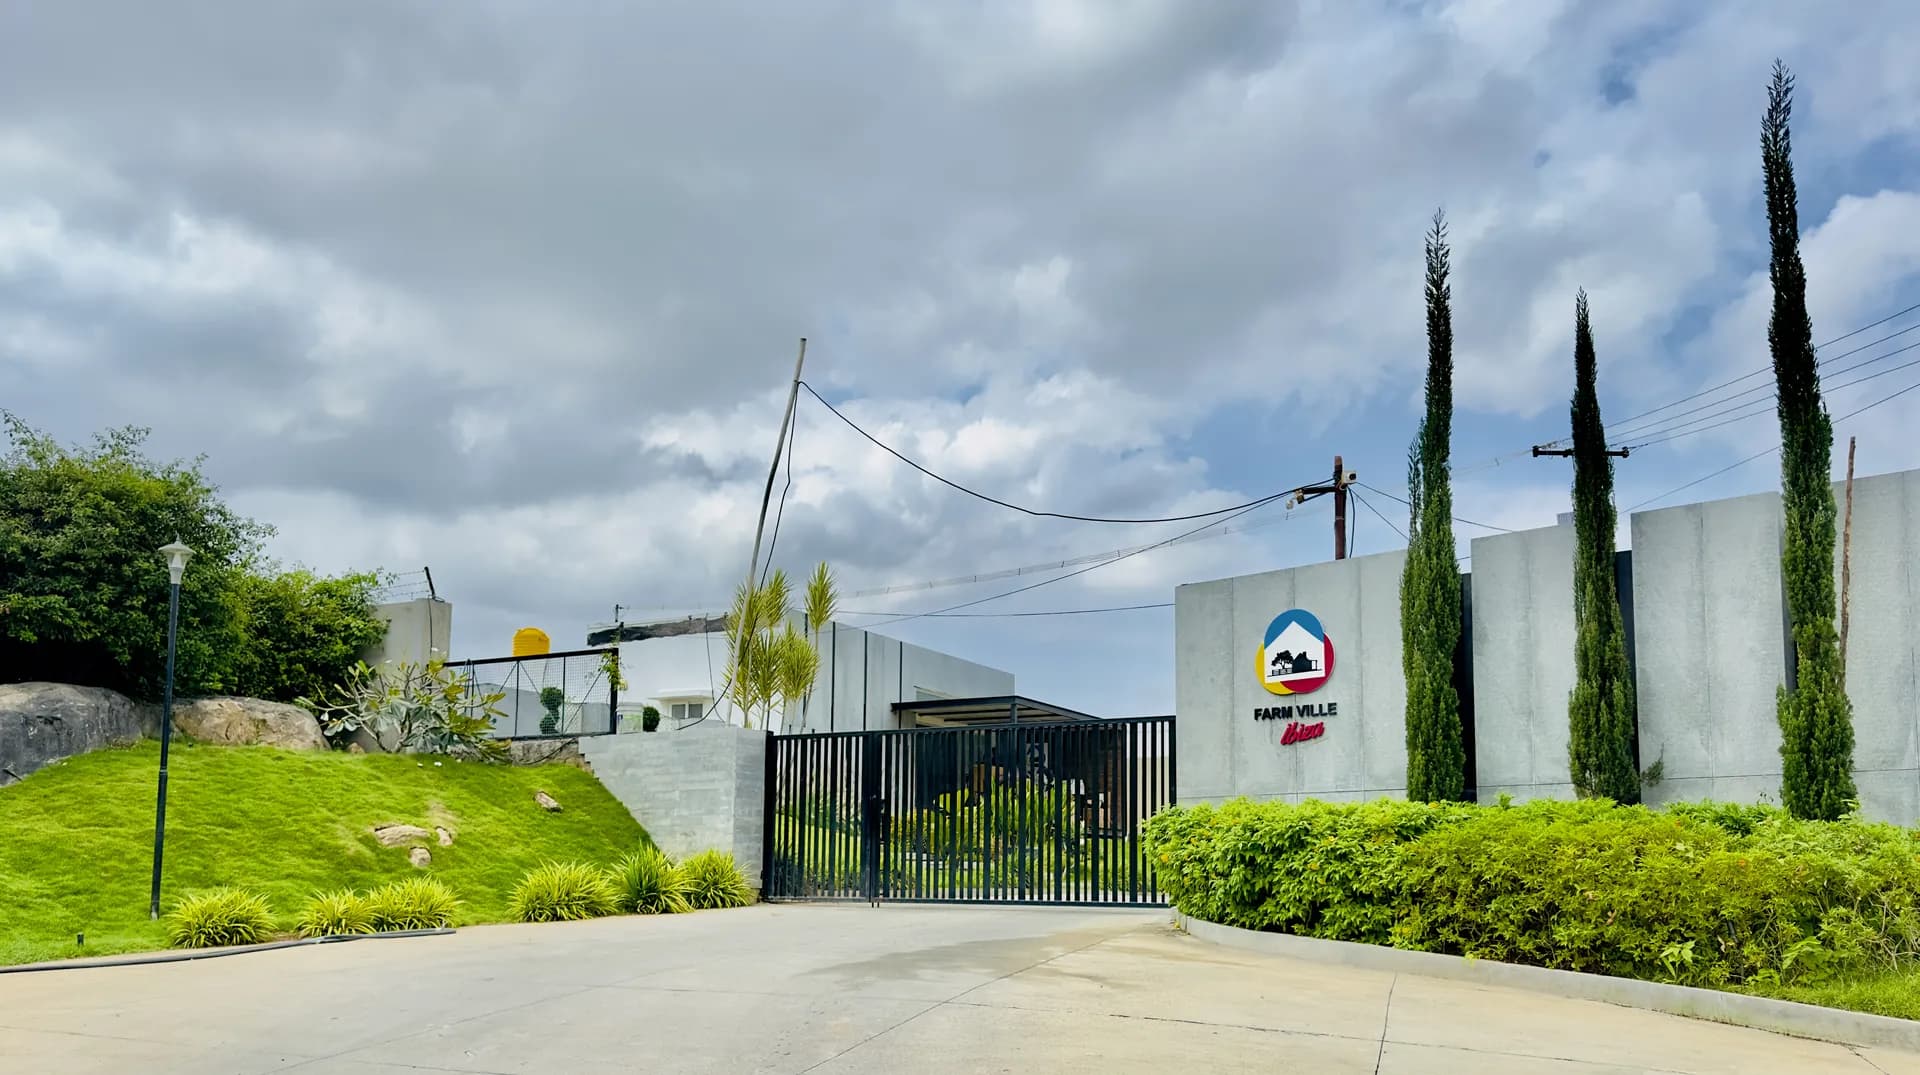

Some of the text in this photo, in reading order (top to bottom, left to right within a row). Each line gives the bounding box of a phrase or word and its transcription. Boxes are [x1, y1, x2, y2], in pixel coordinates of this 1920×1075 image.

[1254, 703, 1338, 721] FARM VILLE
[1280, 721, 1325, 745] ibiza
